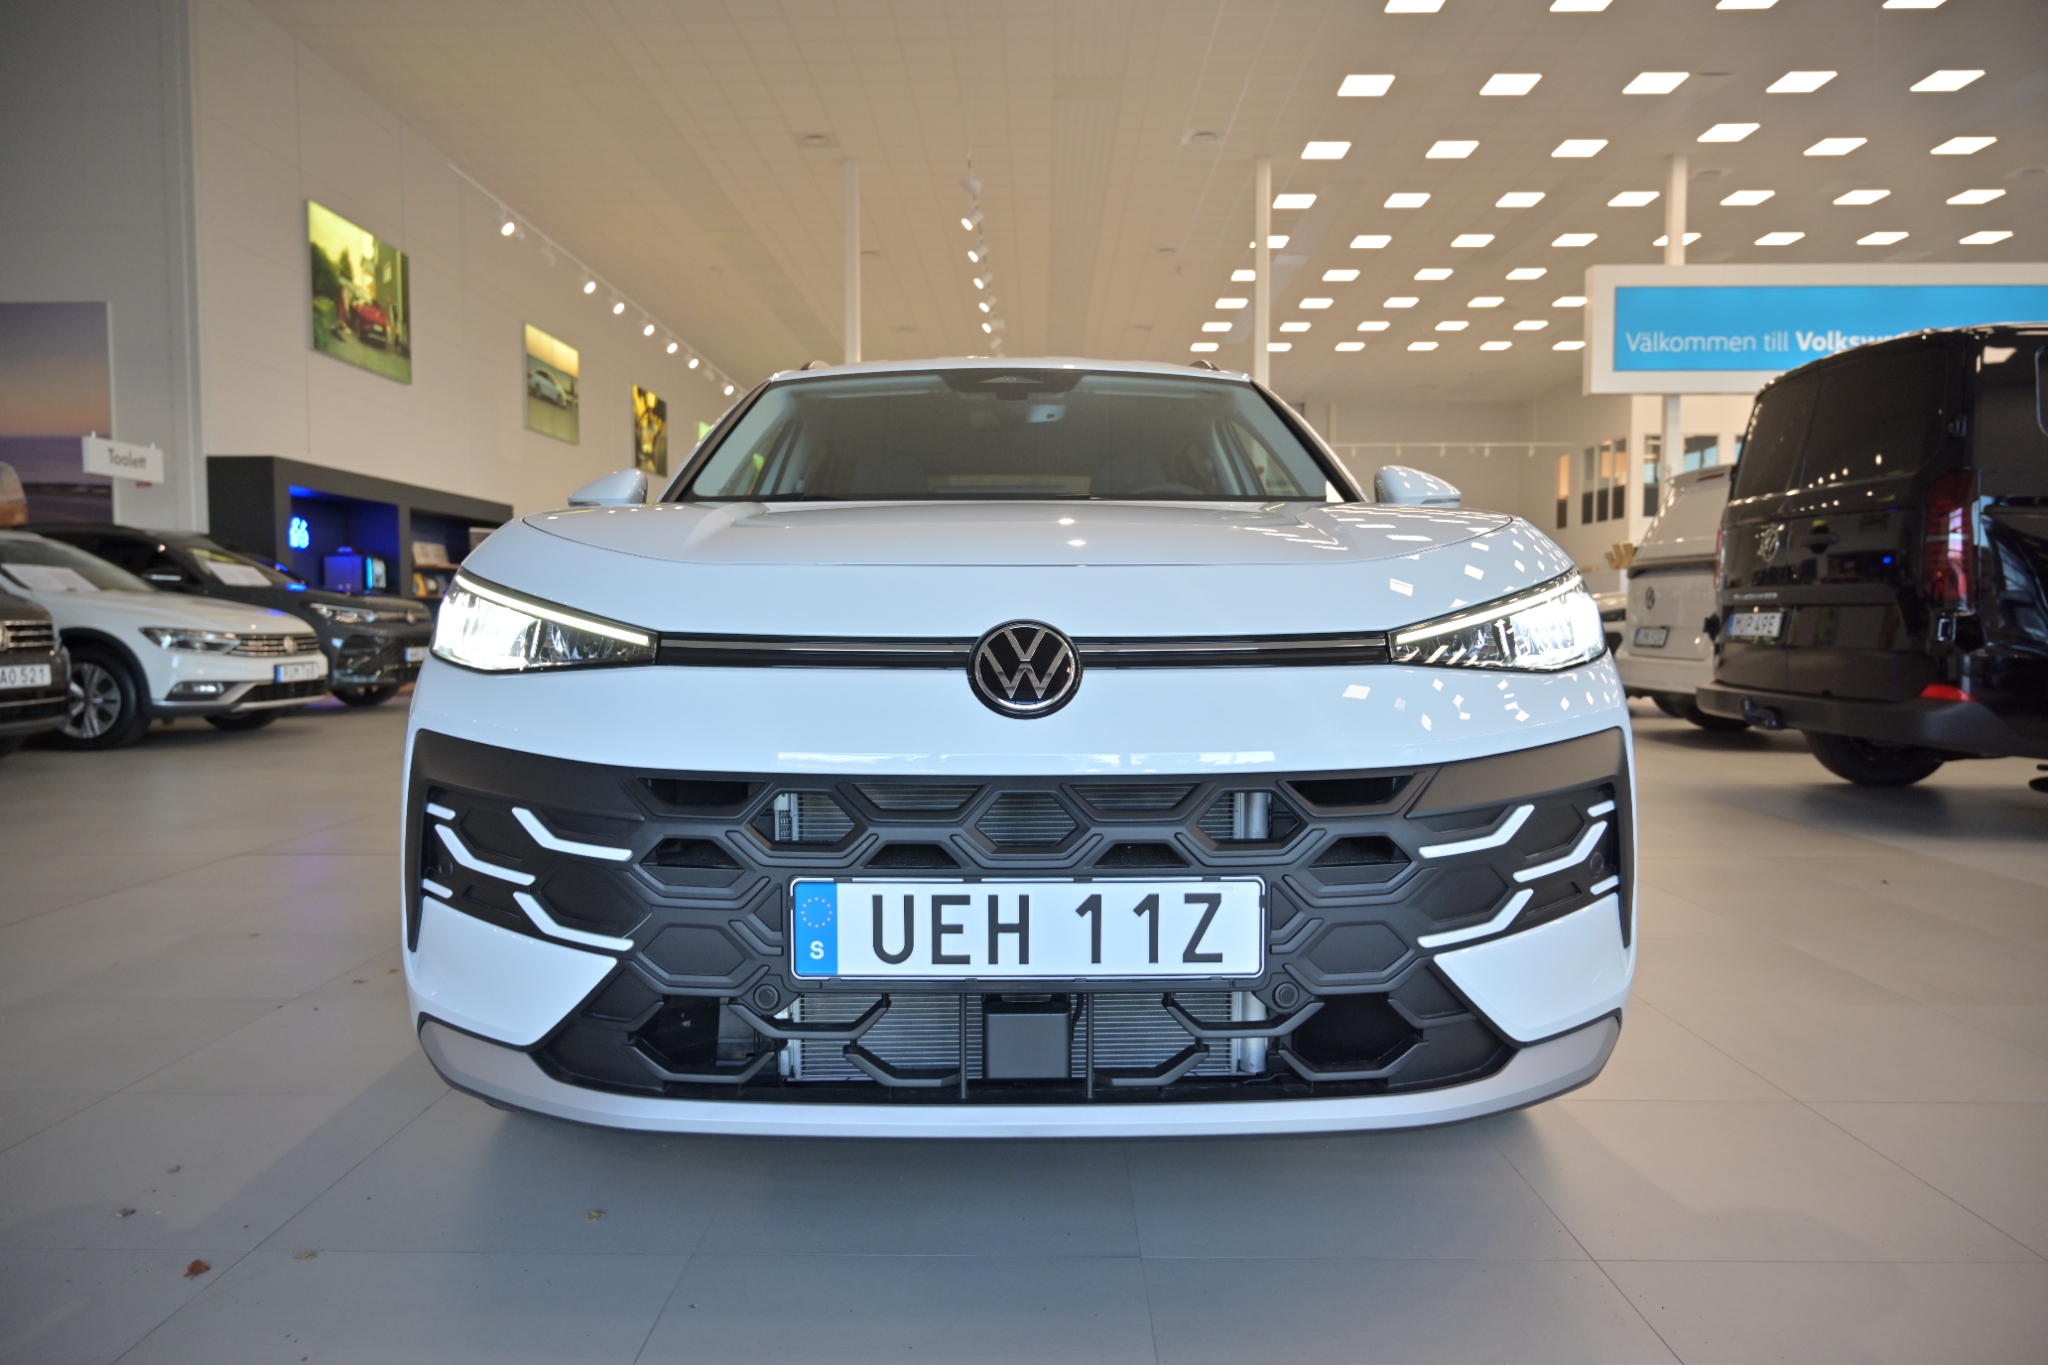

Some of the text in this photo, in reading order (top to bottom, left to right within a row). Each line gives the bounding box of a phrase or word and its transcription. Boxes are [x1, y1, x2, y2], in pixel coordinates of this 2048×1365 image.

[1625, 331, 1757, 352] Välkommen
[1763, 331, 1789, 352] till
[108, 447, 147, 470] Toalett
[1754, 615, 1776, 635] 49E
[20, 666, 45, 684] 521
[872, 892, 1223, 964] UEH 11Z
[810, 940, 825, 960] S
